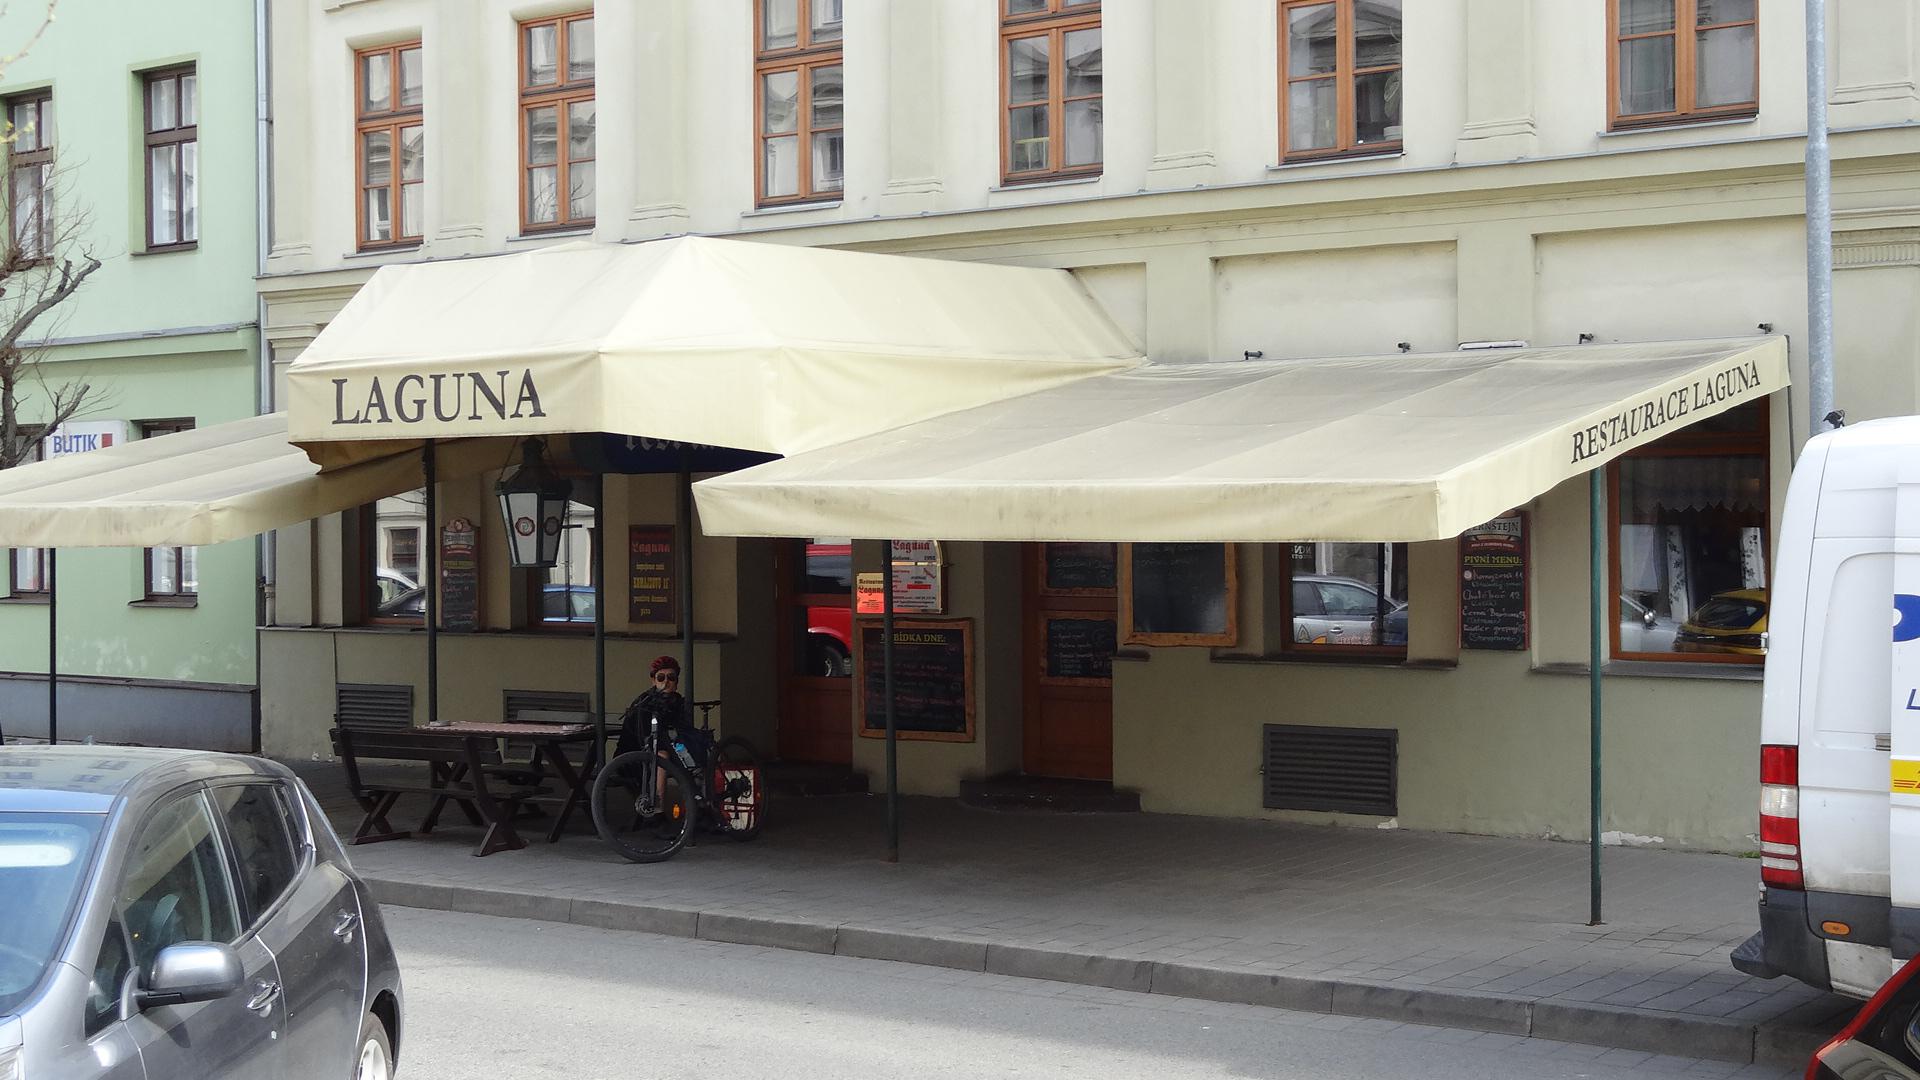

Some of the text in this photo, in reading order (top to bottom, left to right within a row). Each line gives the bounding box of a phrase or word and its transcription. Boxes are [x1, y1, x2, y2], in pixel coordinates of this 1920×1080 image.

[332, 369, 546, 424] LAGUNA
[1571, 360, 1760, 464] RESTAURACE LAGUNA
[53, 434, 98, 453] BUTIK
[1471, 520, 1519, 532] ERNŠTEJN
[893, 540, 930, 553] Laguna
[1464, 554, 1490, 564] PIVNÍ
[880, 632, 921, 642] NBÍDKA
